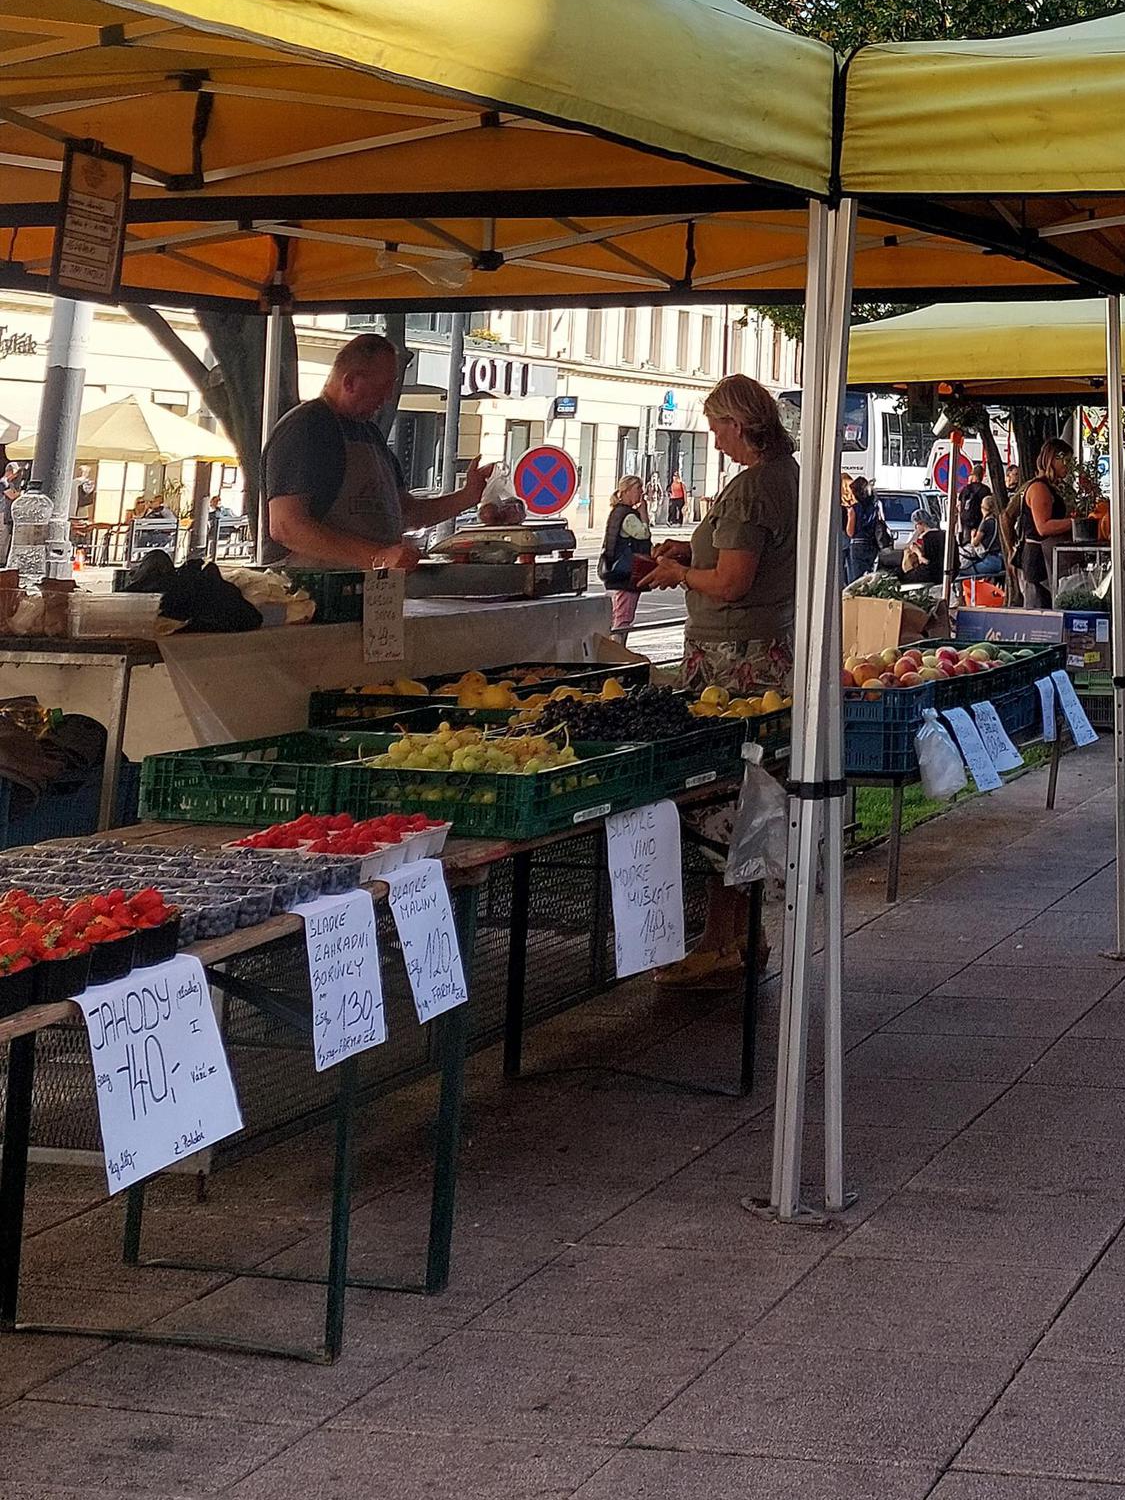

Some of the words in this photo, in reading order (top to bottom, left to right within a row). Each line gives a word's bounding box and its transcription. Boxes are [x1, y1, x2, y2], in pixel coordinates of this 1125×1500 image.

[310, 904, 350, 938] SLADKÉ
[400, 891, 437, 921] MALINY
[315, 921, 372, 963] ZAHRADNÍ
[88, 978, 171, 1050] JAHODY
[116, 1034, 181, 1121] 140,-
